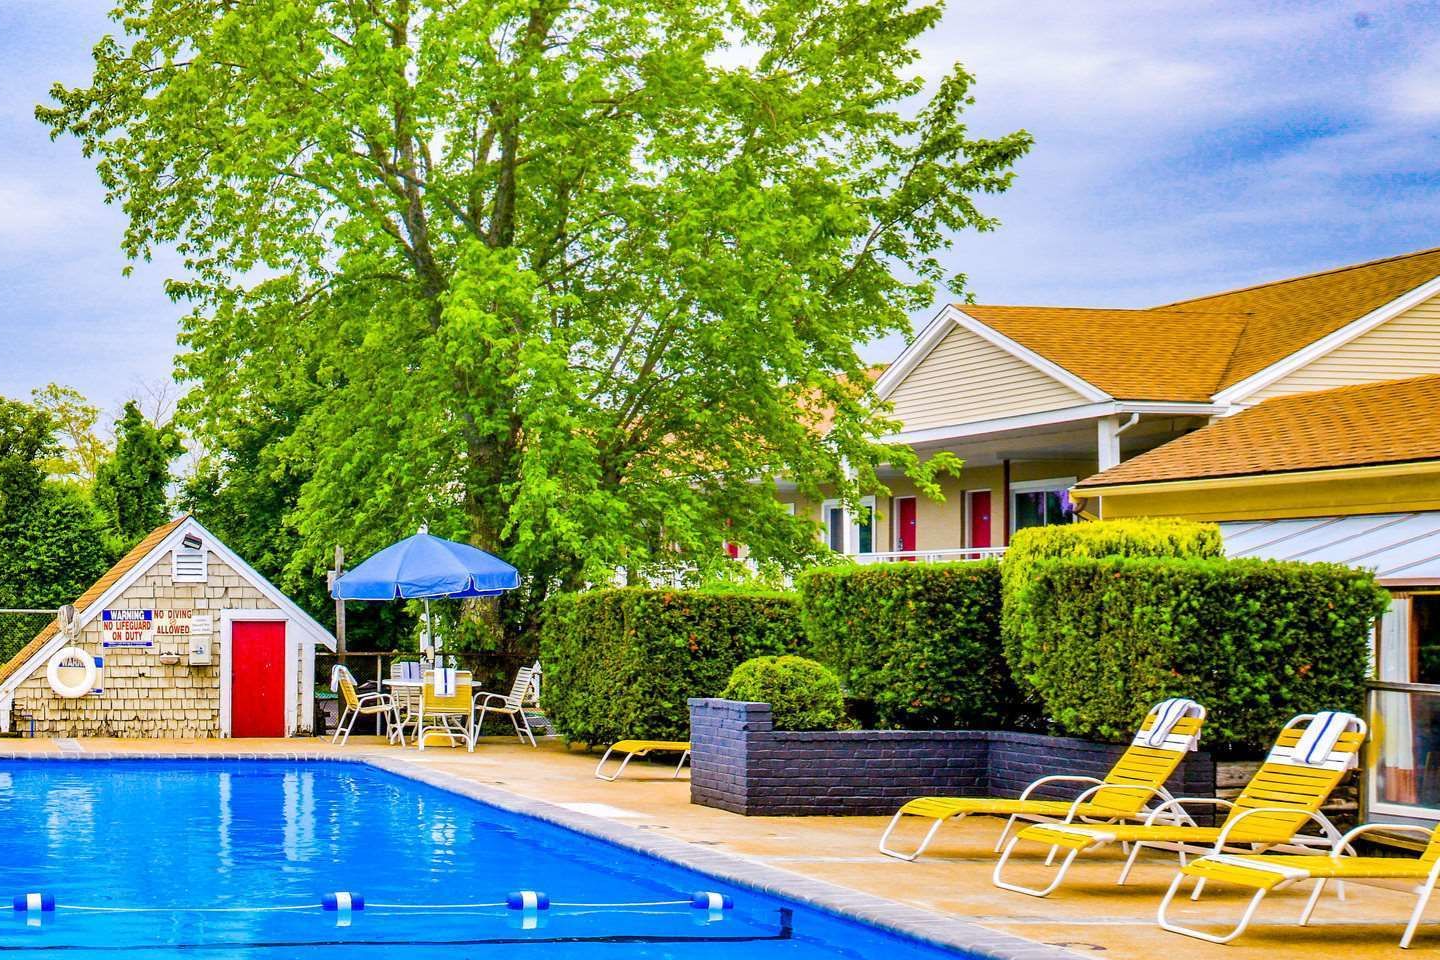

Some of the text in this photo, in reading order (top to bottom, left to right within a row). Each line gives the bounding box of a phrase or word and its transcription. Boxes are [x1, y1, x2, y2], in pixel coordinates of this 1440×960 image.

[111, 610, 144, 620] WARNING
[153, 610, 191, 619] NO DIVING
[103, 621, 151, 630] NO LIFEGUARD
[157, 625, 190, 634] ALLOWED
[112, 632, 143, 641] ON DUTY
